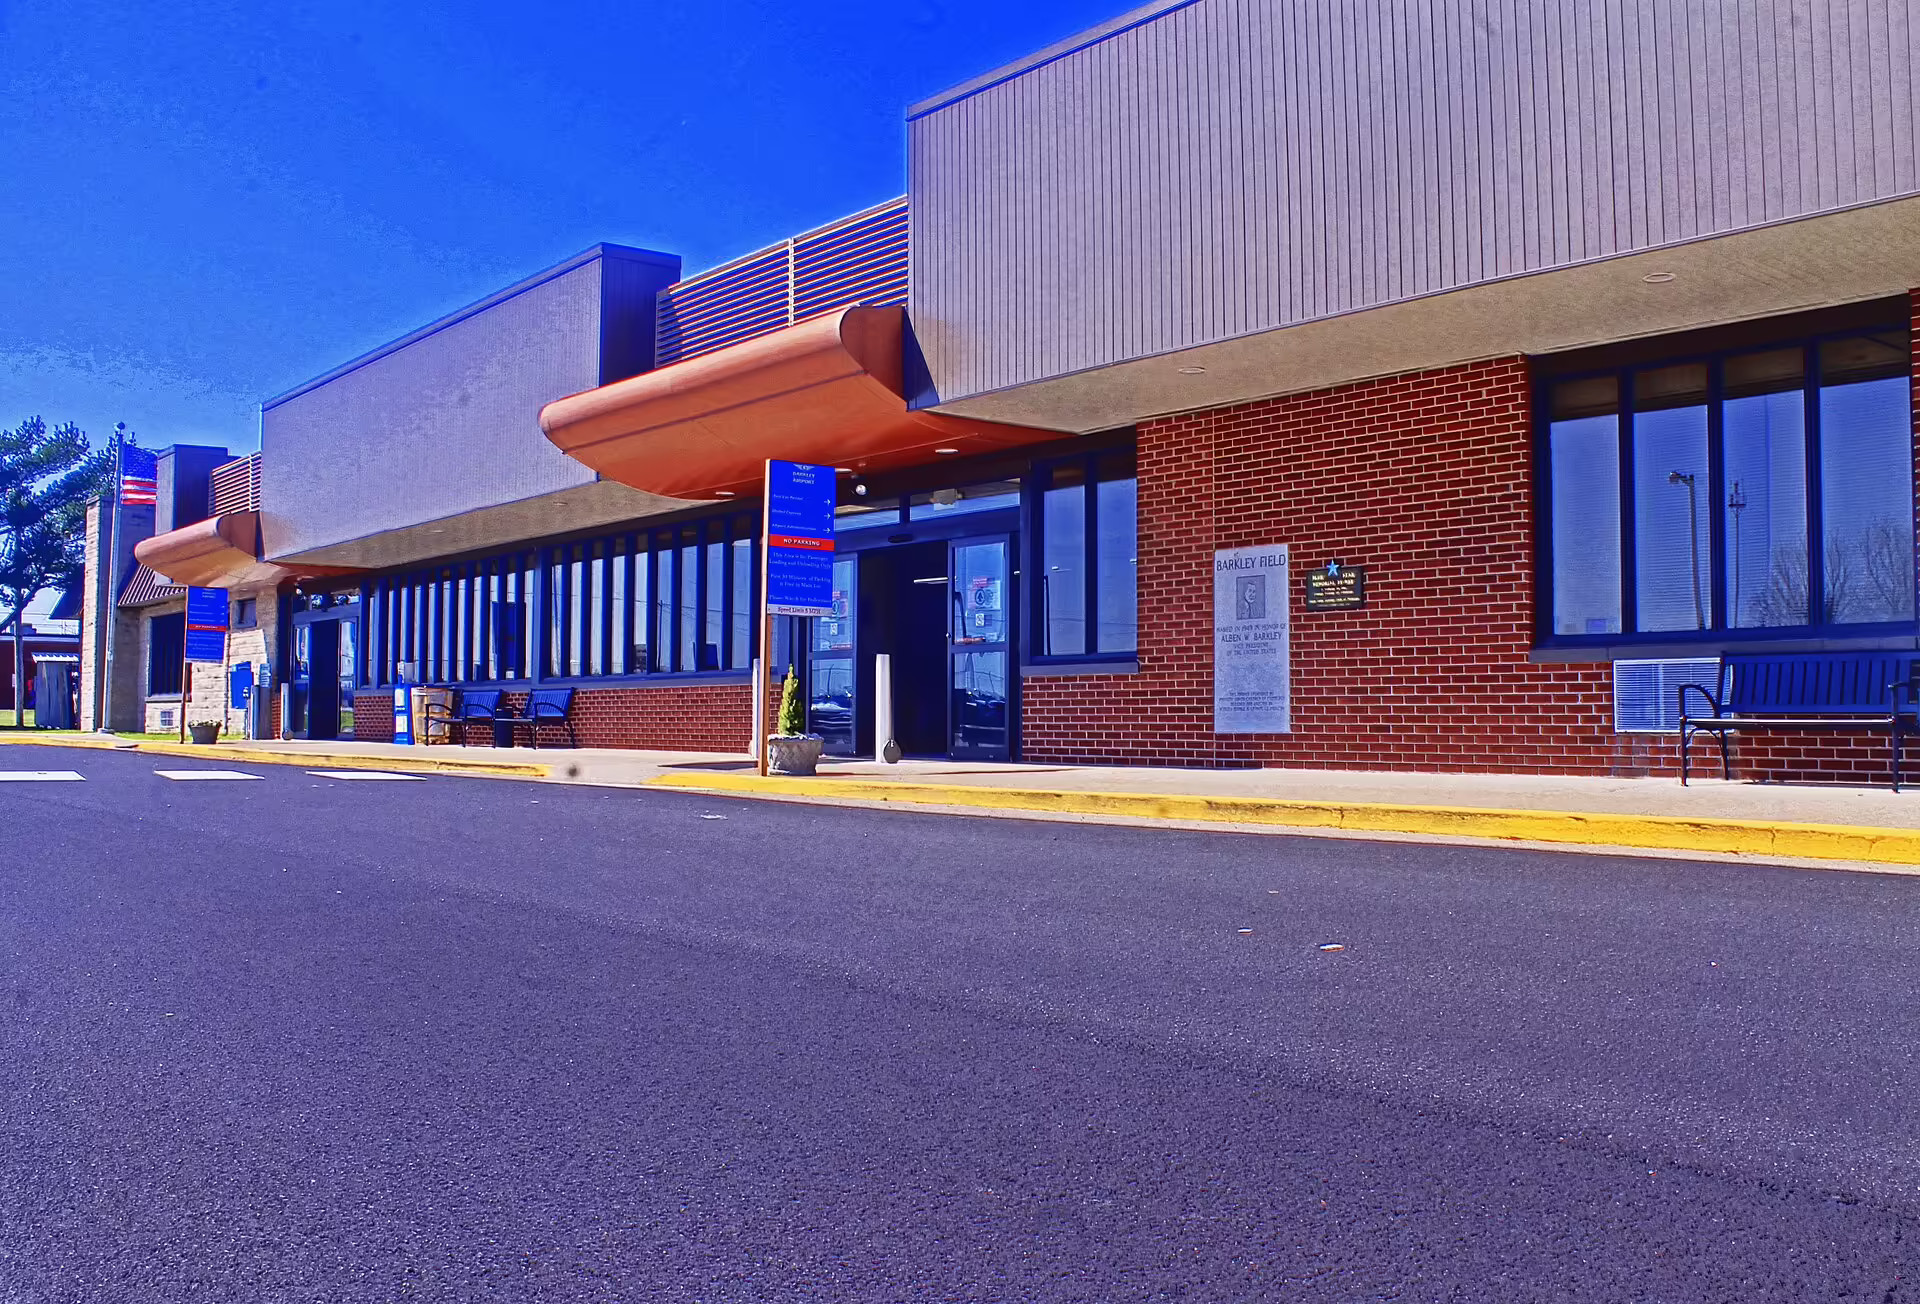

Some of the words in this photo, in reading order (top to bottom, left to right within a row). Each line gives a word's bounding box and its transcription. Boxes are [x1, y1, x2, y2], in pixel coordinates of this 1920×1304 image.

[794, 539, 821, 547] PARKING
[1216, 556, 1257, 571] BARKLEY
[1259, 554, 1286, 568] FIELD
[1221, 633, 1242, 643] ALBEN
[1253, 631, 1283, 641] BARKLEY
